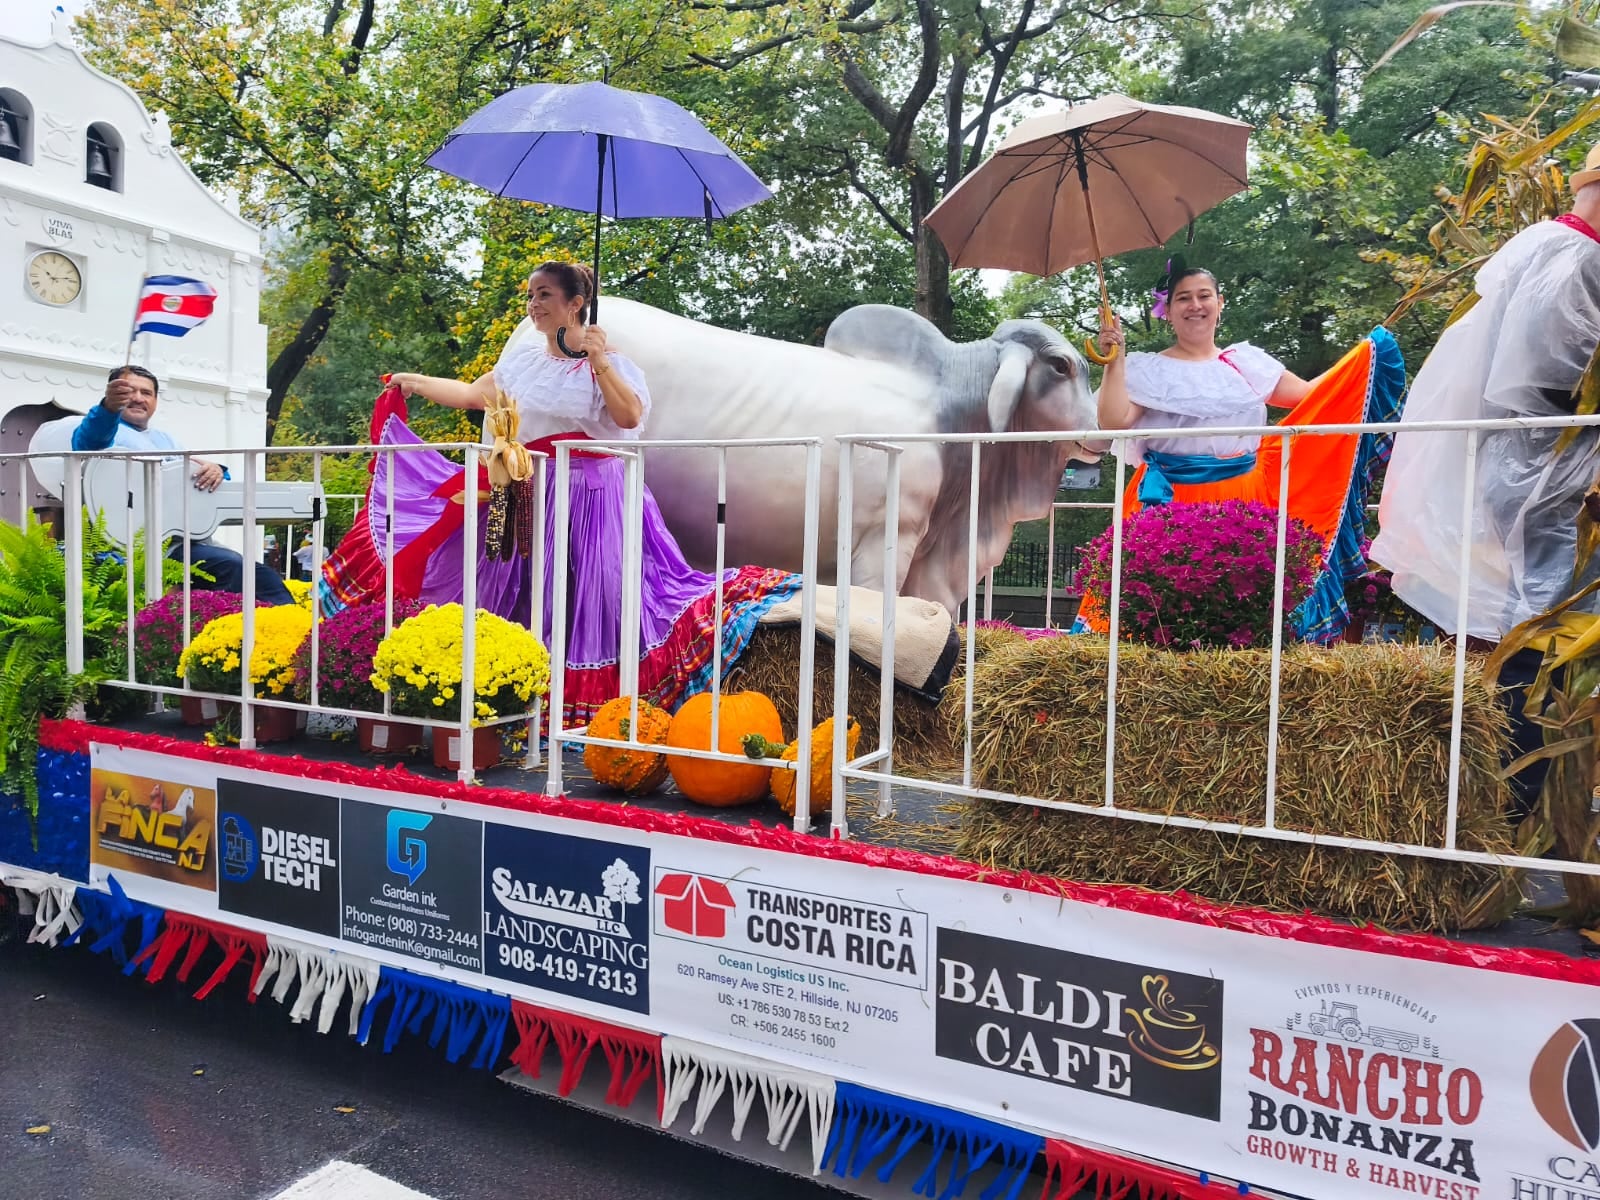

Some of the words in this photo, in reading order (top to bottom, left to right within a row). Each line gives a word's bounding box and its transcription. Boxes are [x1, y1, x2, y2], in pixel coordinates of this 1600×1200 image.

[48, 226, 73, 240] BLAS
[177, 852, 205, 871] NJ
[262, 827, 336, 867] DIESEL
[261, 854, 320, 891] TECH
[492, 867, 614, 919] SALAZAR
[370, 896, 401, 910] Customized
[401, 903, 425, 915] Business
[425, 908, 450, 921] Uniforms
[382, 883, 419, 904] Garden
[421, 891, 437, 908] ink
[747, 888, 892, 934] TRANSPORTES
[898, 916, 913, 939] A
[346, 905, 385, 928] Phone:
[387, 914, 417, 937] (908)
[420, 922, 478, 950] 733-2444
[484, 911, 649, 970] LANDSCAPING
[595, 920, 621, 934] LLC
[747, 914, 836, 958] COSTA
[845, 933, 917, 976] RICA
[499, 943, 637, 996] 908-419-7313
[718, 954, 753, 971] Ocean
[756, 961, 805, 984] Logistics
[809, 973, 825, 987] US
[828, 977, 849, 993] Inc.
[677, 963, 695, 977] 620
[697, 967, 738, 989] Ramsey
[740, 977, 759, 991] Ave
[762, 982, 784, 998] STE
[800, 990, 842, 1012] Hillside,
[846, 1001, 861, 1015] NJ
[864, 1005, 899, 1023] 07205
[718, 992, 735, 1006] US:
[737, 996, 749, 1010] +1
[750, 1000, 770, 1015] 786
[771, 1004, 791, 1019] 530
[793, 1009, 807, 1023] 78
[808, 1012, 822, 1027] 53
[824, 1016, 842, 1031] Ext
[842, 1021, 849, 1033] 2
[939, 957, 1127, 1039] BALDI
[1294, 983, 1341, 1000] EVENTOS
[1345, 983, 1352, 993] Y
[1357, 984, 1438, 1024] EXPERIENCIAS
[731, 1014, 749, 1028] CR:
[753, 1021, 778, 1035] +506
[781, 1027, 807, 1041] 2455
[811, 1033, 836, 1048] 1600
[976, 1022, 1132, 1097] CAFE
[1249, 1027, 1484, 1126] RANCHO
[1248, 1090, 1481, 1183] BONANZA
[1246, 1134, 1338, 1174] GROWTH
[1345, 1158, 1361, 1179] &
[1368, 1162, 1480, 1200] HARVEST
